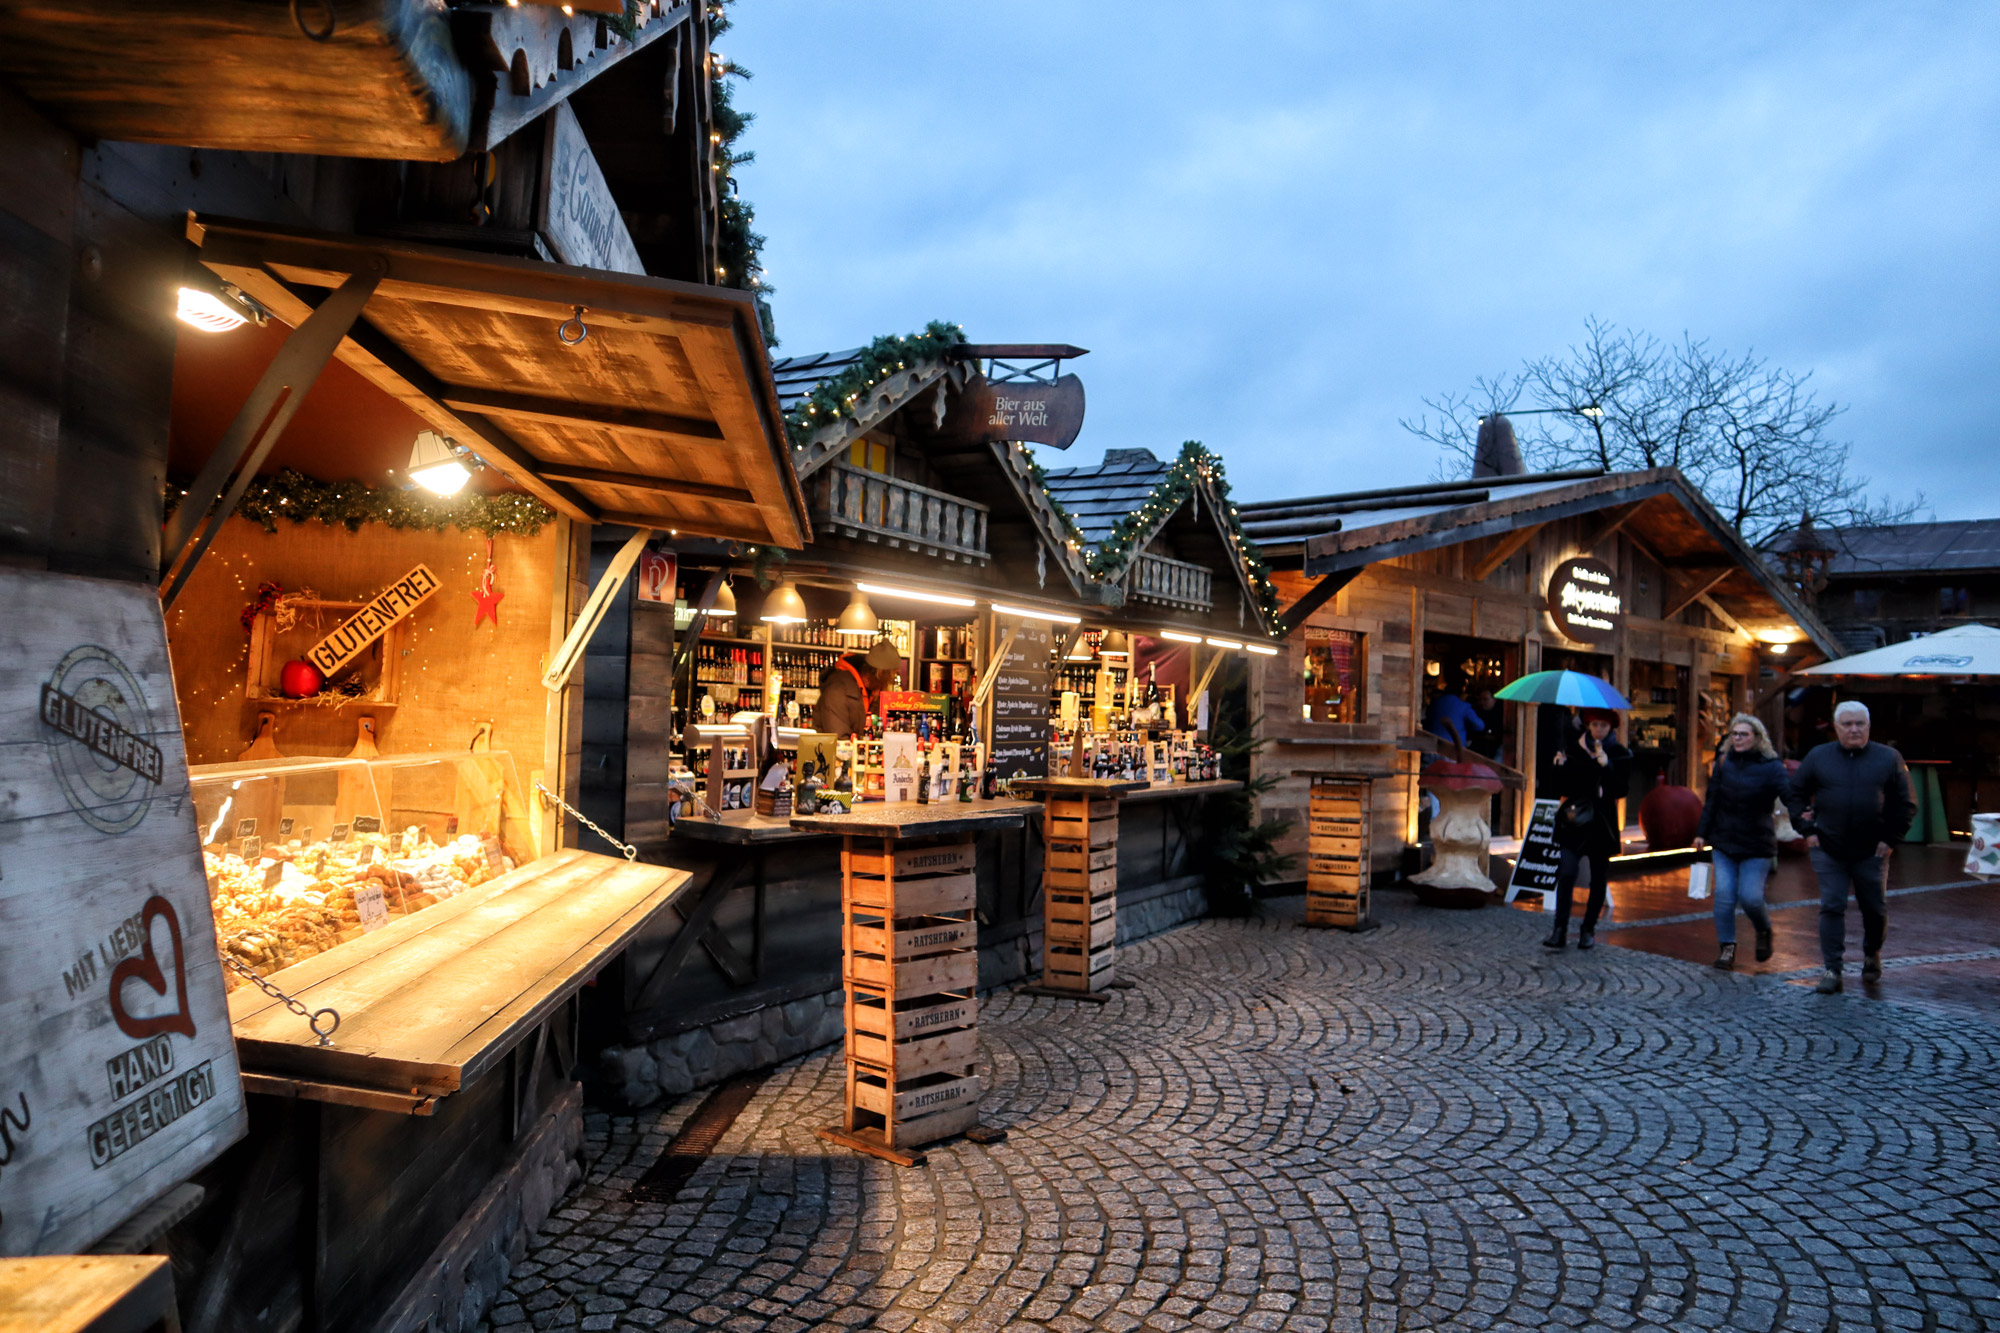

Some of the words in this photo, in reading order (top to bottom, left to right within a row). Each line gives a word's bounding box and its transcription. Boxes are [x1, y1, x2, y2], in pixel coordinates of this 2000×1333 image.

[996, 397, 1019, 411] Bier
[1023, 400, 1045, 411] aus
[988, 411, 1015, 425] aller
[1018, 411, 1048, 426] Welt
[314, 568, 436, 670] GLUTENFREI
[890, 701, 912, 711] Merry
[913, 702, 942, 710] Christmas
[43, 688, 163, 781] GLUTENFREI
[913, 854, 958, 867] RATSHERRN
[913, 931, 959, 947] RATSHERRN
[63, 950, 98, 1000] MIT
[99, 911, 148, 968] LIEBE
[914, 1009, 960, 1027] RATSHERRN
[107, 1034, 172, 1101] HAND
[915, 1087, 961, 1107] RATSHERRN
[88, 1062, 214, 1168] GEFERTIGT
